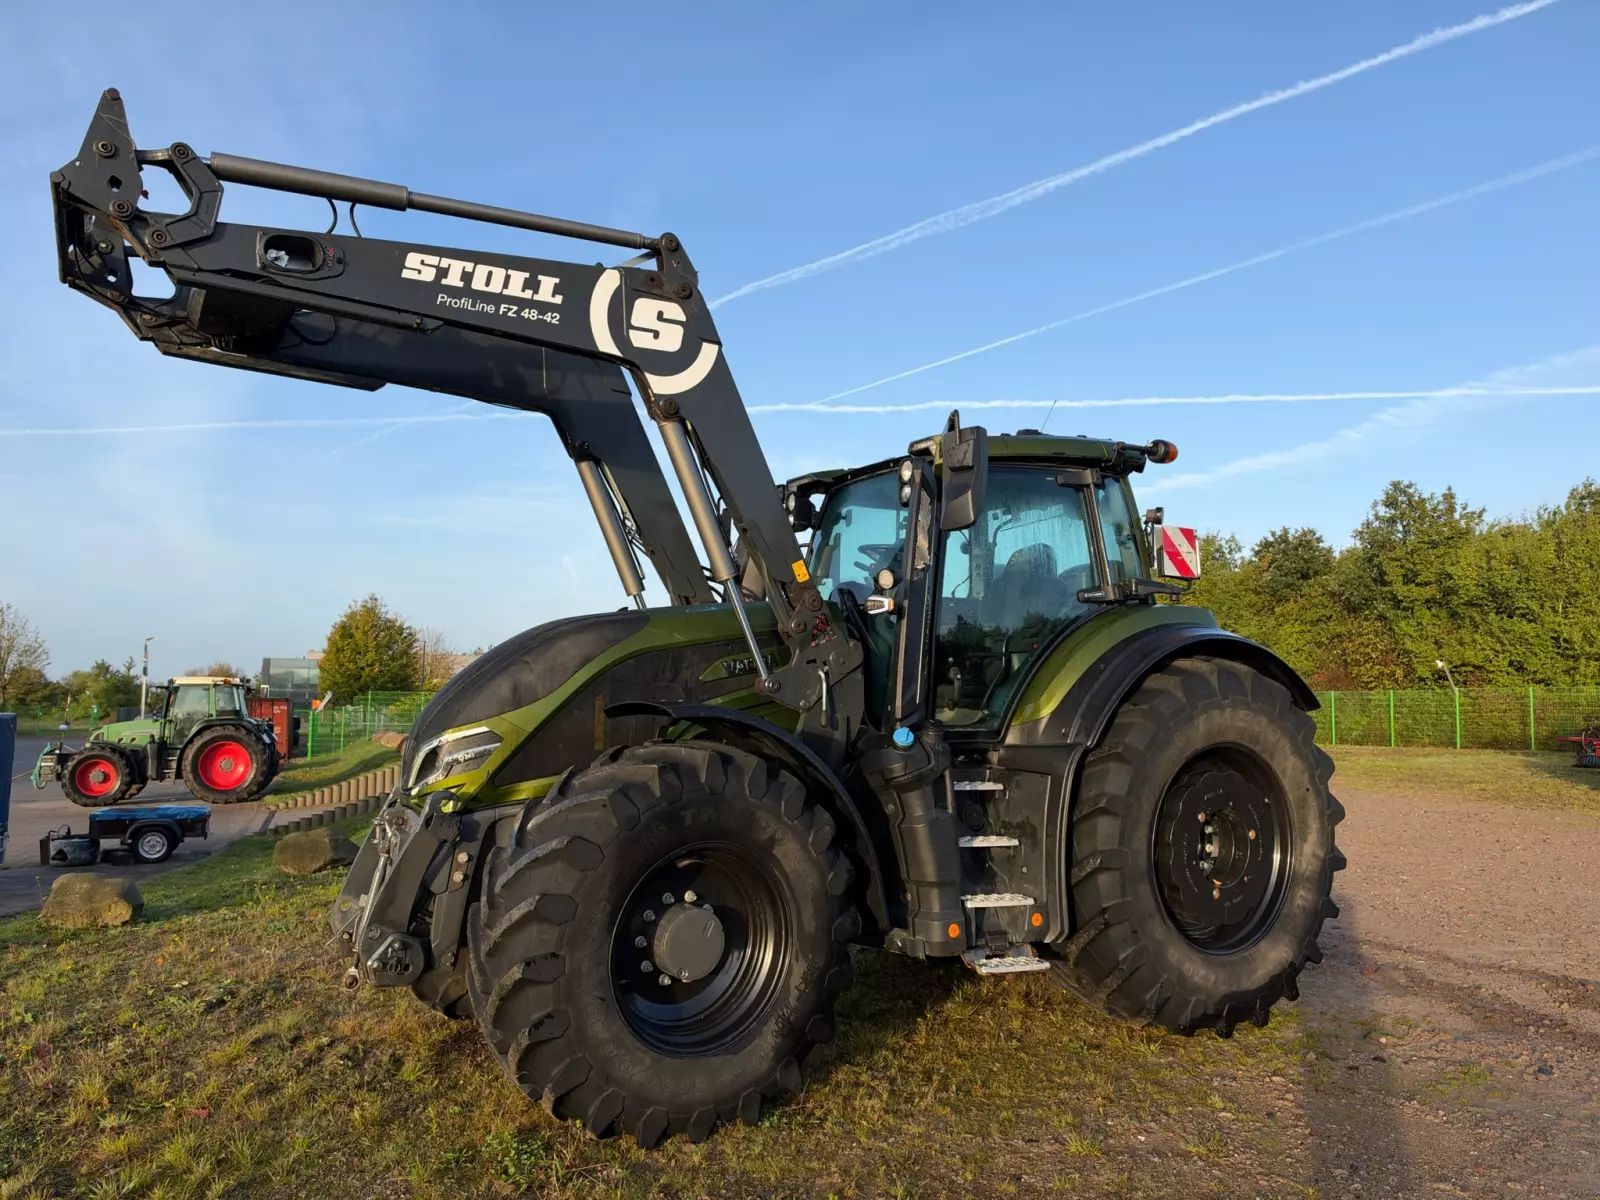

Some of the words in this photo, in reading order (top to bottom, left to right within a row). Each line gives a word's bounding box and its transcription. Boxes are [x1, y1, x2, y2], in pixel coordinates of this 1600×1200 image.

[401, 252, 563, 304] STOLL
[437, 293, 495, 314] ProfiLine
[499, 304, 517, 317] FZ
[520, 309, 560, 324] 48-42
[629, 297, 687, 352] S
